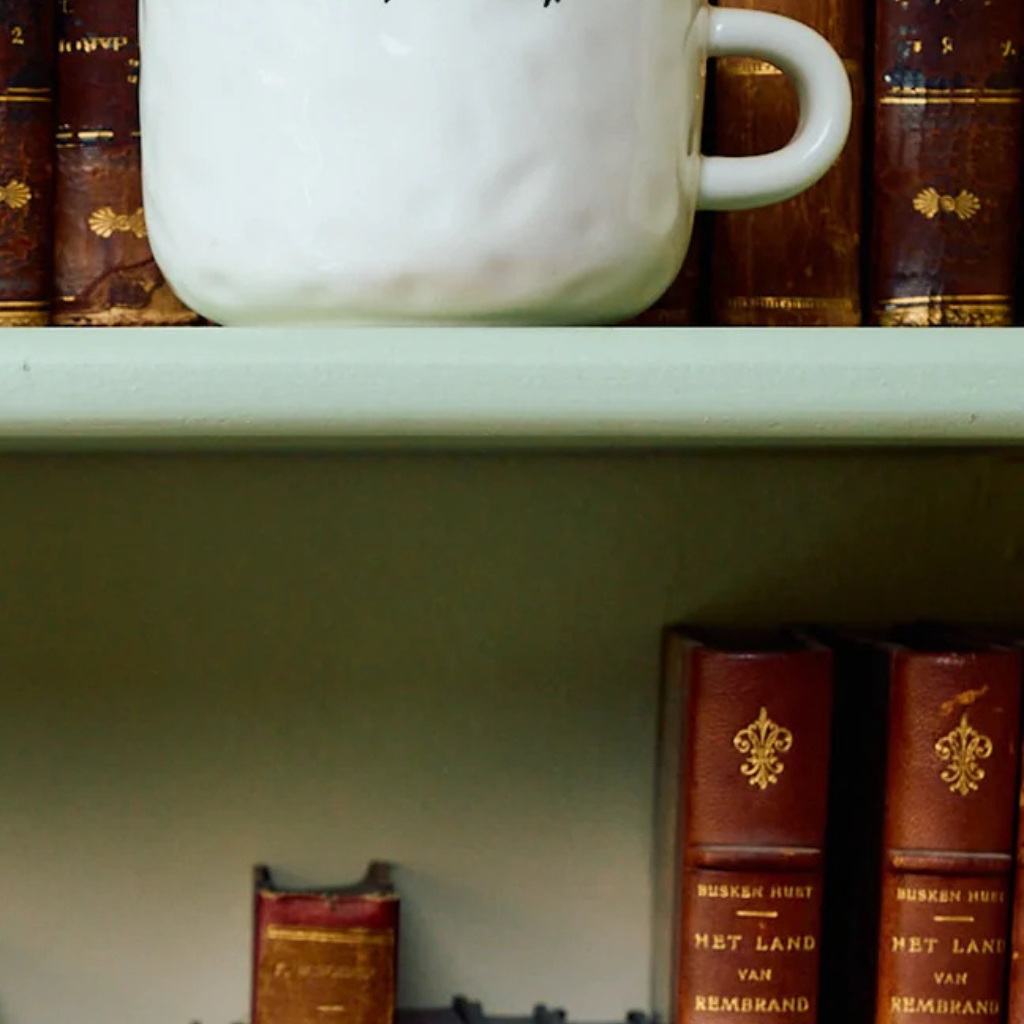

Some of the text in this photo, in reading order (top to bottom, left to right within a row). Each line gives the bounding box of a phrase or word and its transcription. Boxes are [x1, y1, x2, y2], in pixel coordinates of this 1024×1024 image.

[695, 932, 816, 951] HET LAND
[892, 935, 939, 954] HET
[738, 968, 773, 981] VAN
[933, 972, 969, 985] VAN
[695, 995, 810, 1013] REMBRAND
[891, 996, 1000, 1015] REMBRAND
